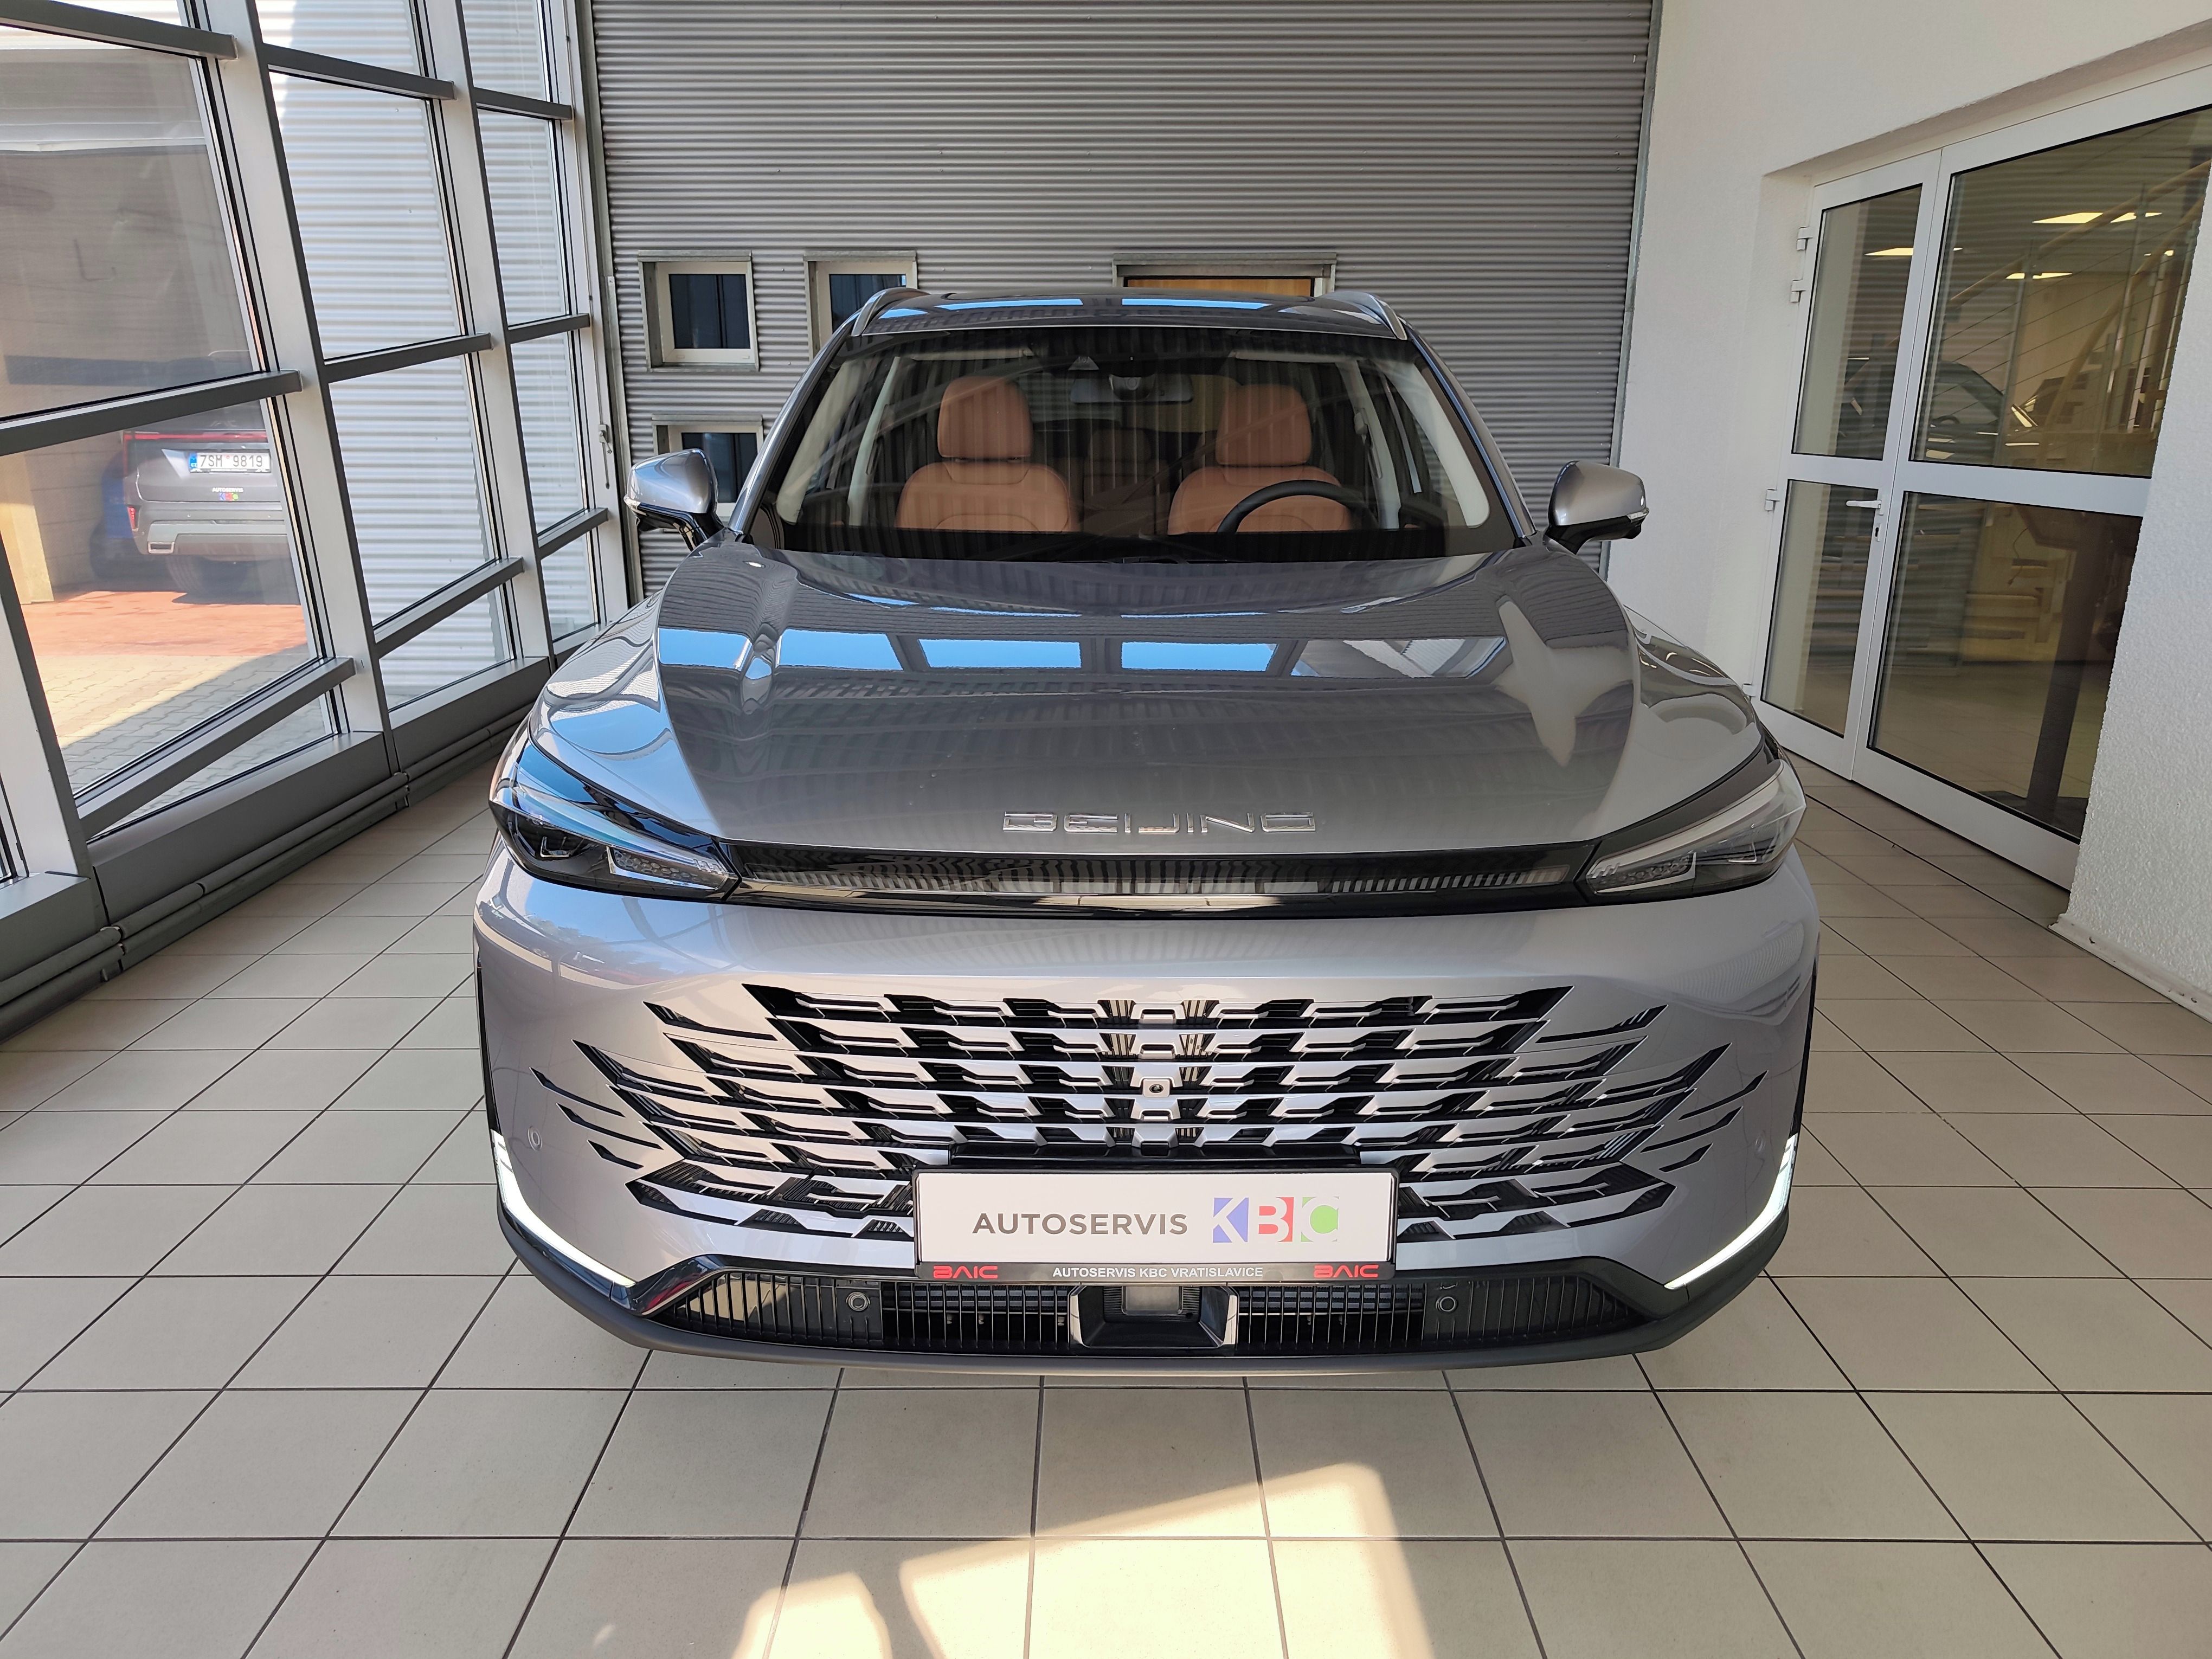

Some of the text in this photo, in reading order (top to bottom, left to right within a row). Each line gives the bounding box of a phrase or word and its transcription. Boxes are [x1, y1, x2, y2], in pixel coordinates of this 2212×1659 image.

[200, 455, 262, 467] 7SM 9819
[1003, 812, 1316, 833] BEIJING
[972, 1196, 1340, 1243] AUTOSERVIS KBC
[933, 1265, 998, 1279] BAIC
[1052, 1267, 1263, 1278] AUTOSERVIS KBC VRATISLAVICE
[1314, 1265, 1379, 1278] BAIC
